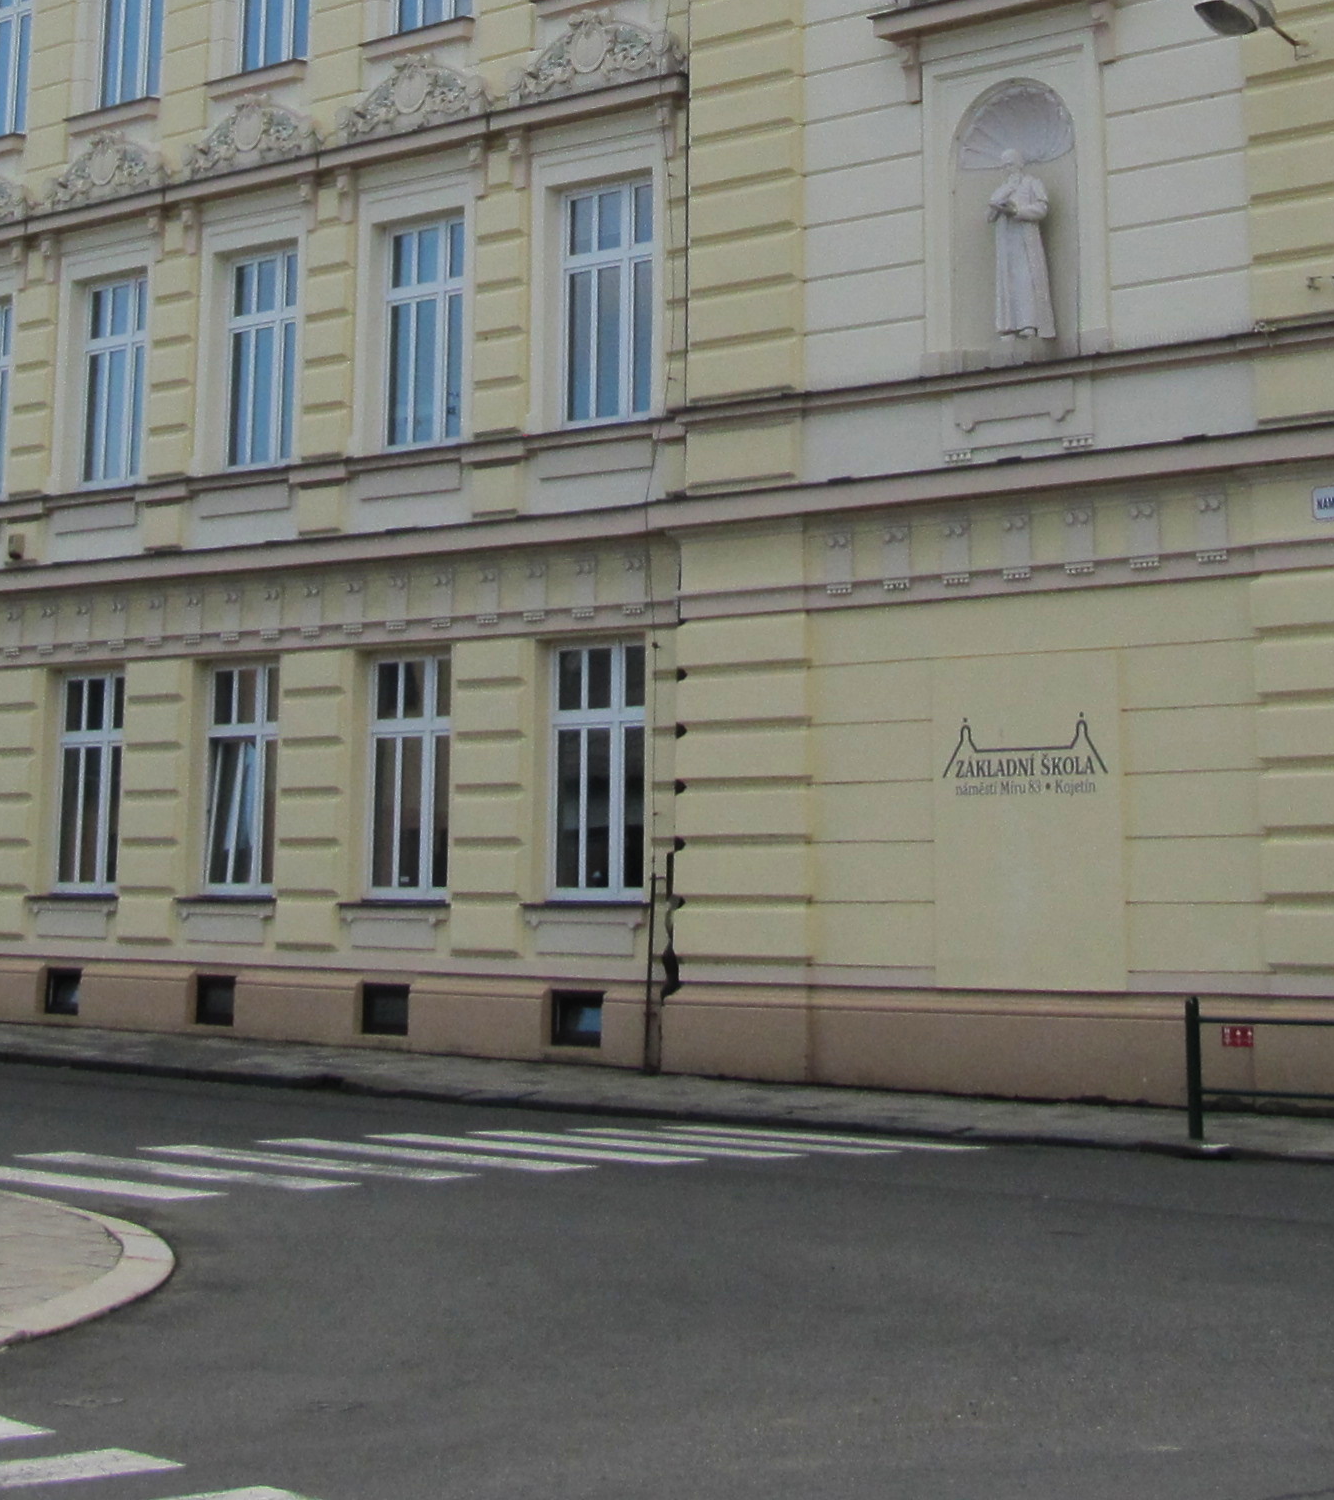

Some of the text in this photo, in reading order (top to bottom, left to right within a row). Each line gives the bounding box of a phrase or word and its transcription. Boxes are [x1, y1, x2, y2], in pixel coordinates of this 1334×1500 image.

[955, 753, 1095, 778] ZÁKLADNÍ ŠKOLA
[955, 781, 997, 796] náměstí
[1000, 780, 1026, 795] Míru
[1055, 779, 1096, 797] Kojetín
